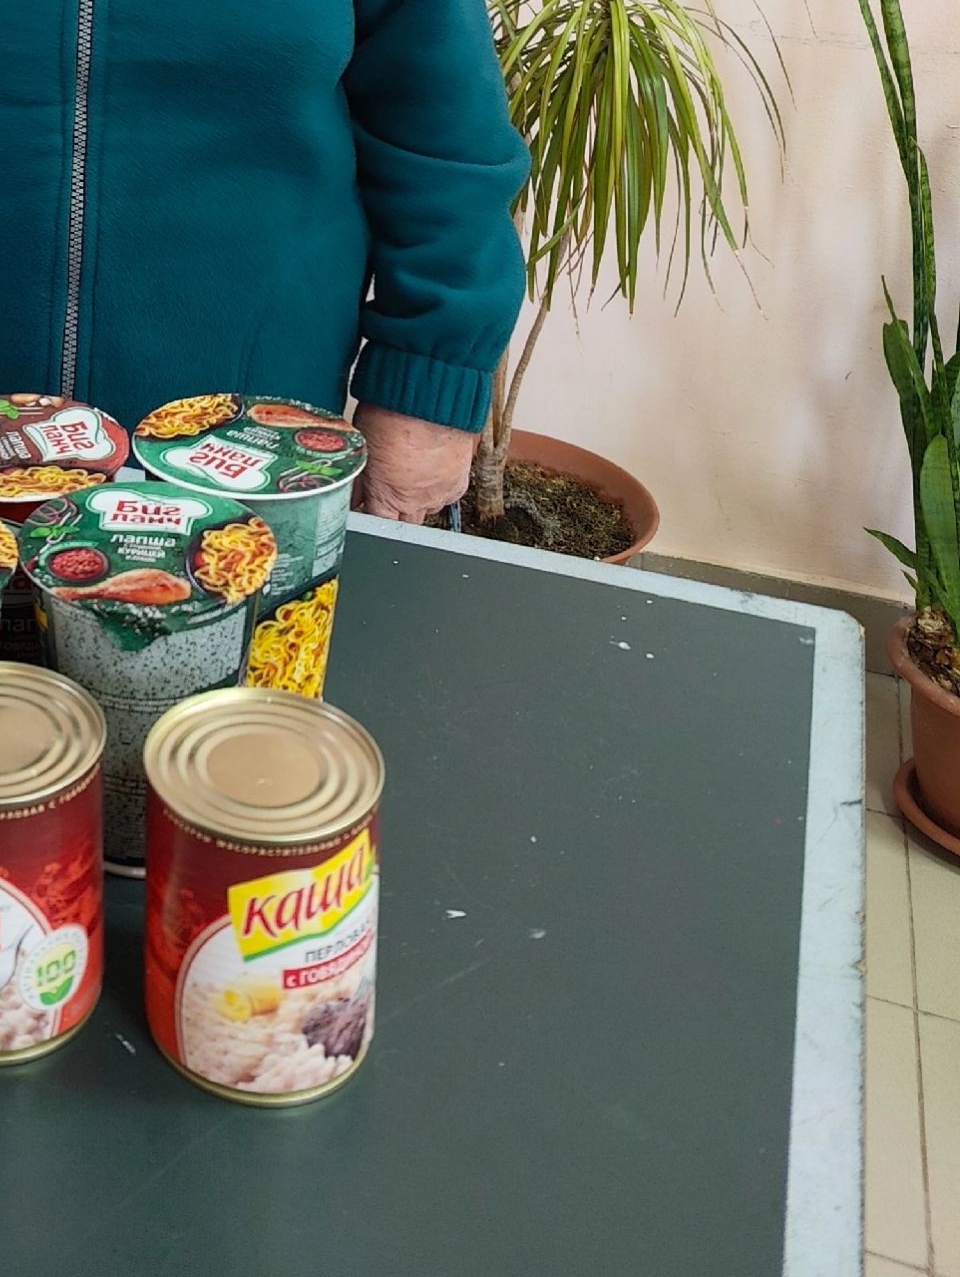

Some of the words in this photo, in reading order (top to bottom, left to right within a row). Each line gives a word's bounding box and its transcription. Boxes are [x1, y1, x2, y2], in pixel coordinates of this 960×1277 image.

[6, 431, 32, 459] лапша
[40, 424, 73, 454] ланч
[59, 421, 95, 450] Биг
[190, 452, 248, 479] Биг
[200, 442, 262, 467] ланч
[111, 513, 182, 526] ланч
[116, 500, 181, 516] Биг
[110, 534, 176, 547] лапша
[285, 976, 297, 987] с
